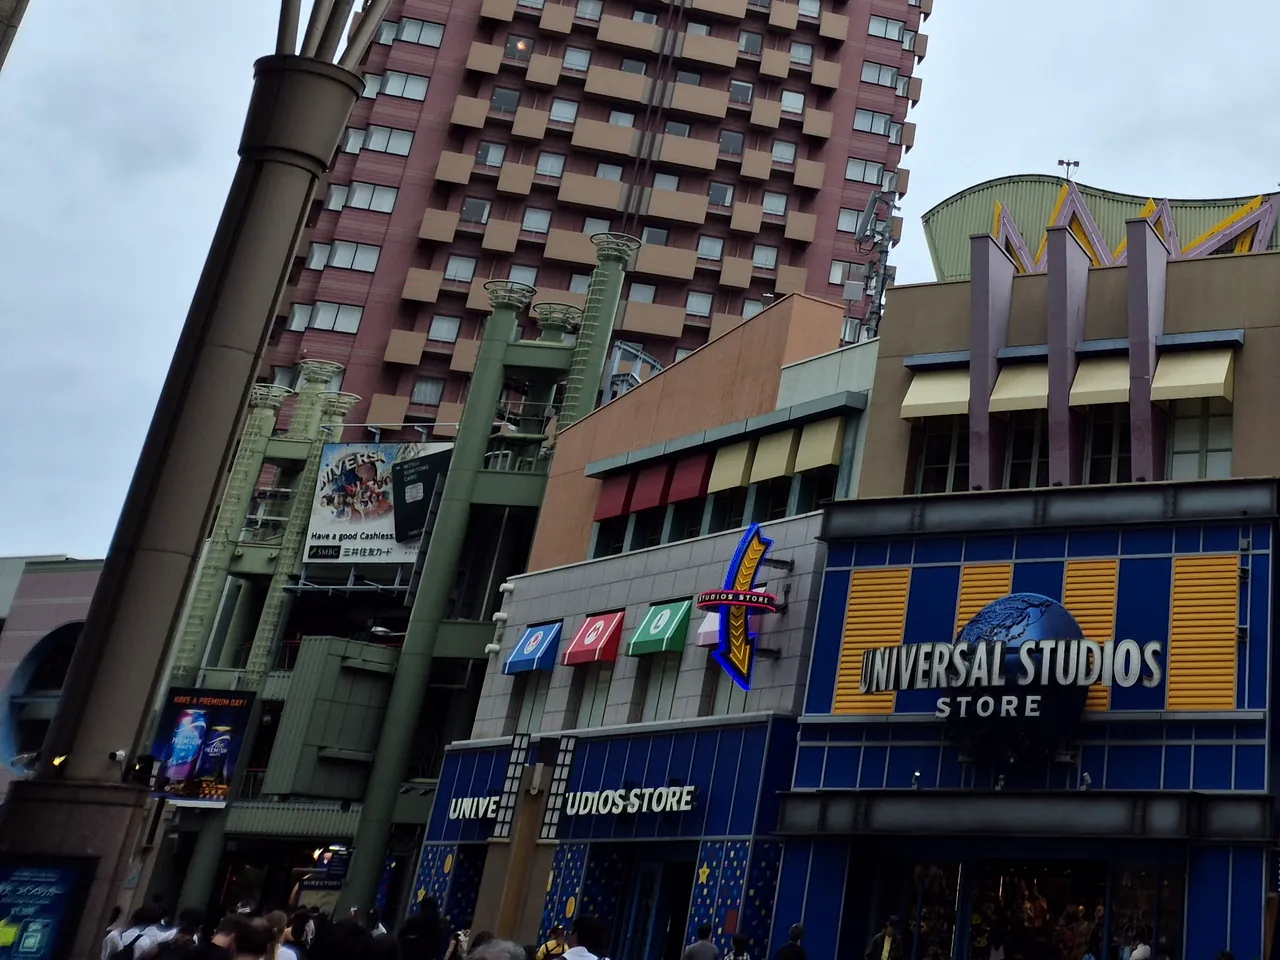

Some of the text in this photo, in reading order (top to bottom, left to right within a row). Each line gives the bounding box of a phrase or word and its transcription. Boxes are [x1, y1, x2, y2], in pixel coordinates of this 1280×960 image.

[311, 532, 330, 540] Have
[339, 531, 358, 542] good
[317, 548, 339, 556] SMBC
[342, 547, 393, 557] 三井住友カード
[738, 594, 769, 604] STORE
[859, 639, 1163, 694] UNIVERSAL STUDIOS
[173, 695, 191, 705] HAVE
[198, 696, 229, 706] PREMIUM
[935, 695, 1042, 719] STORE
[449, 786, 695, 819] UNIVE UDIOS STORE
